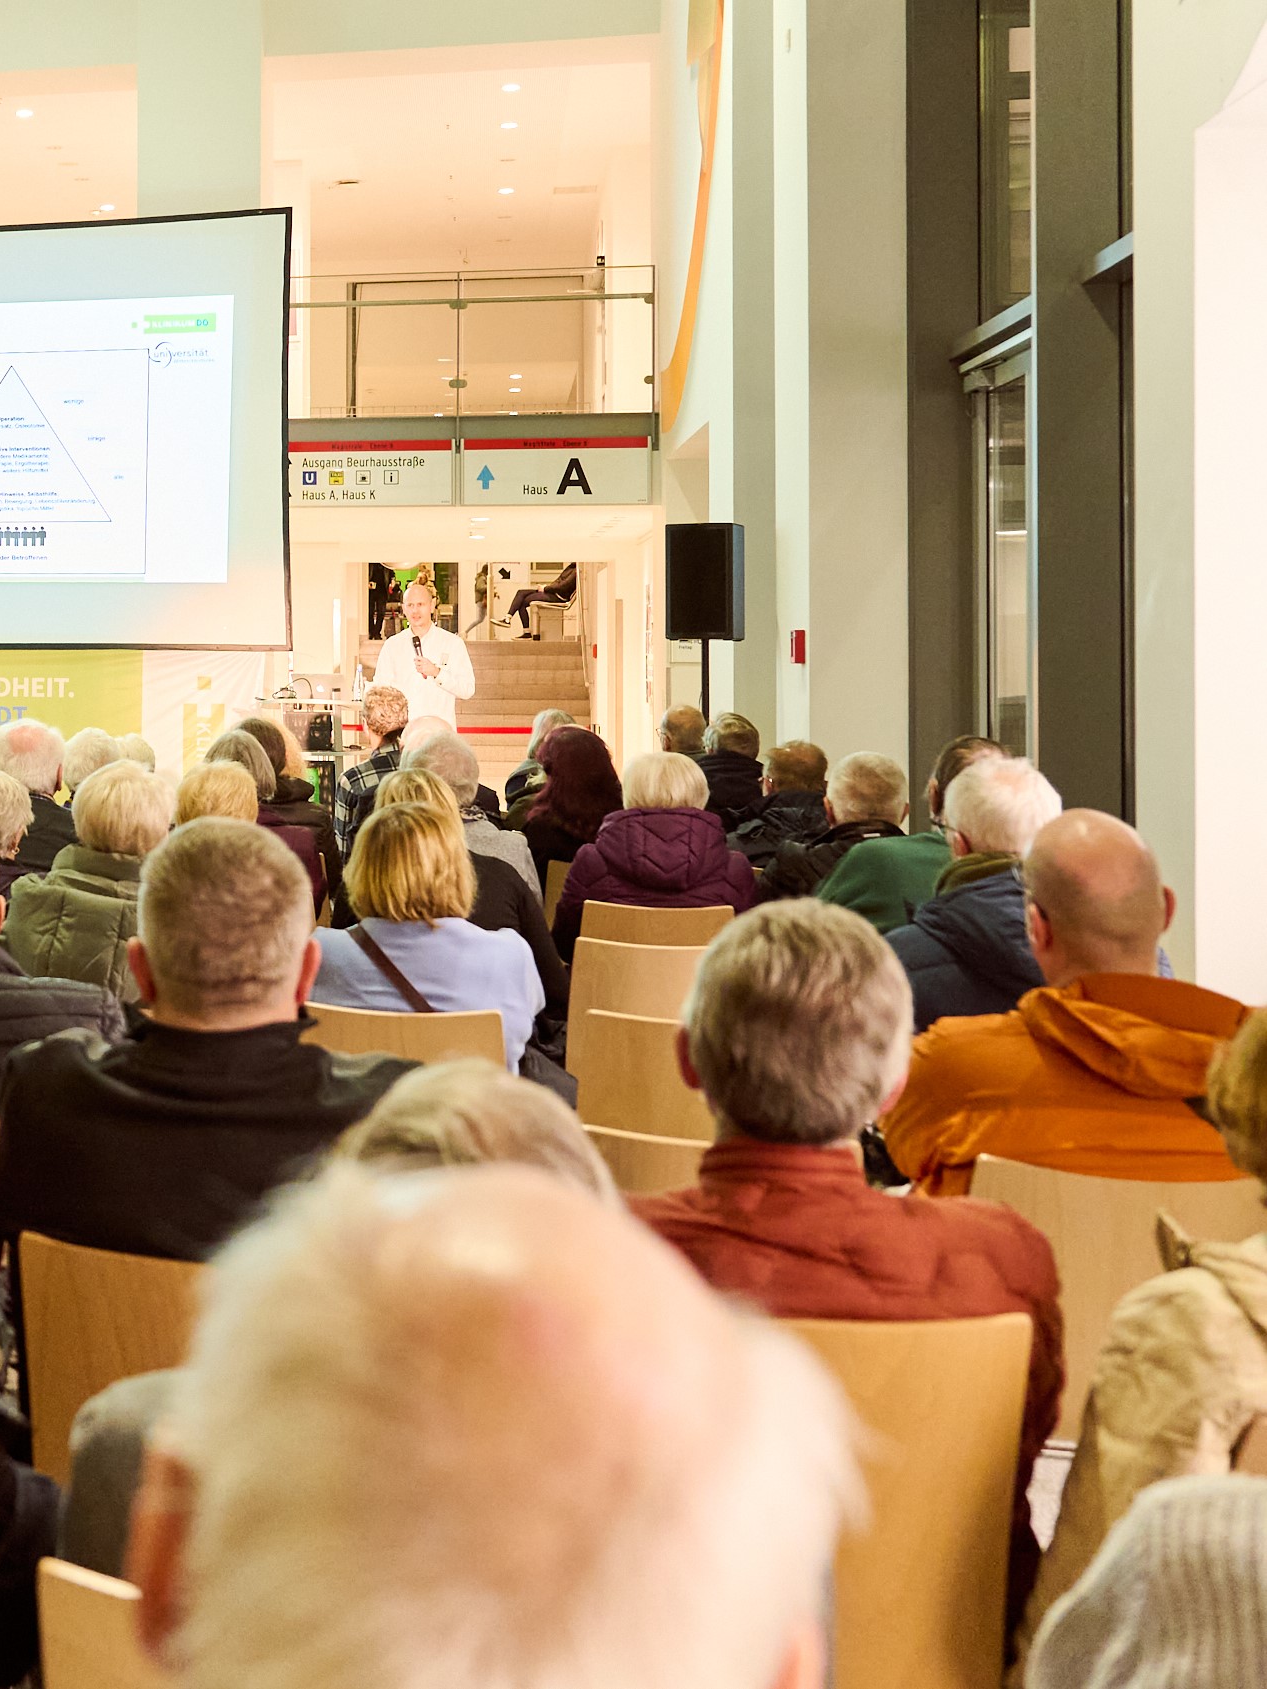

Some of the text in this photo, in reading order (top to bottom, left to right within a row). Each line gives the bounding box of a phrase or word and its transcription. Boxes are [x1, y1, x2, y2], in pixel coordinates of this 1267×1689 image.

[154, 347, 209, 358] universität
[302, 456, 425, 470] Ausgang Beurhausstraße
[305, 473, 314, 483] U
[523, 458, 592, 495] Haus A
[302, 489, 376, 501] Haus A, Haus K
